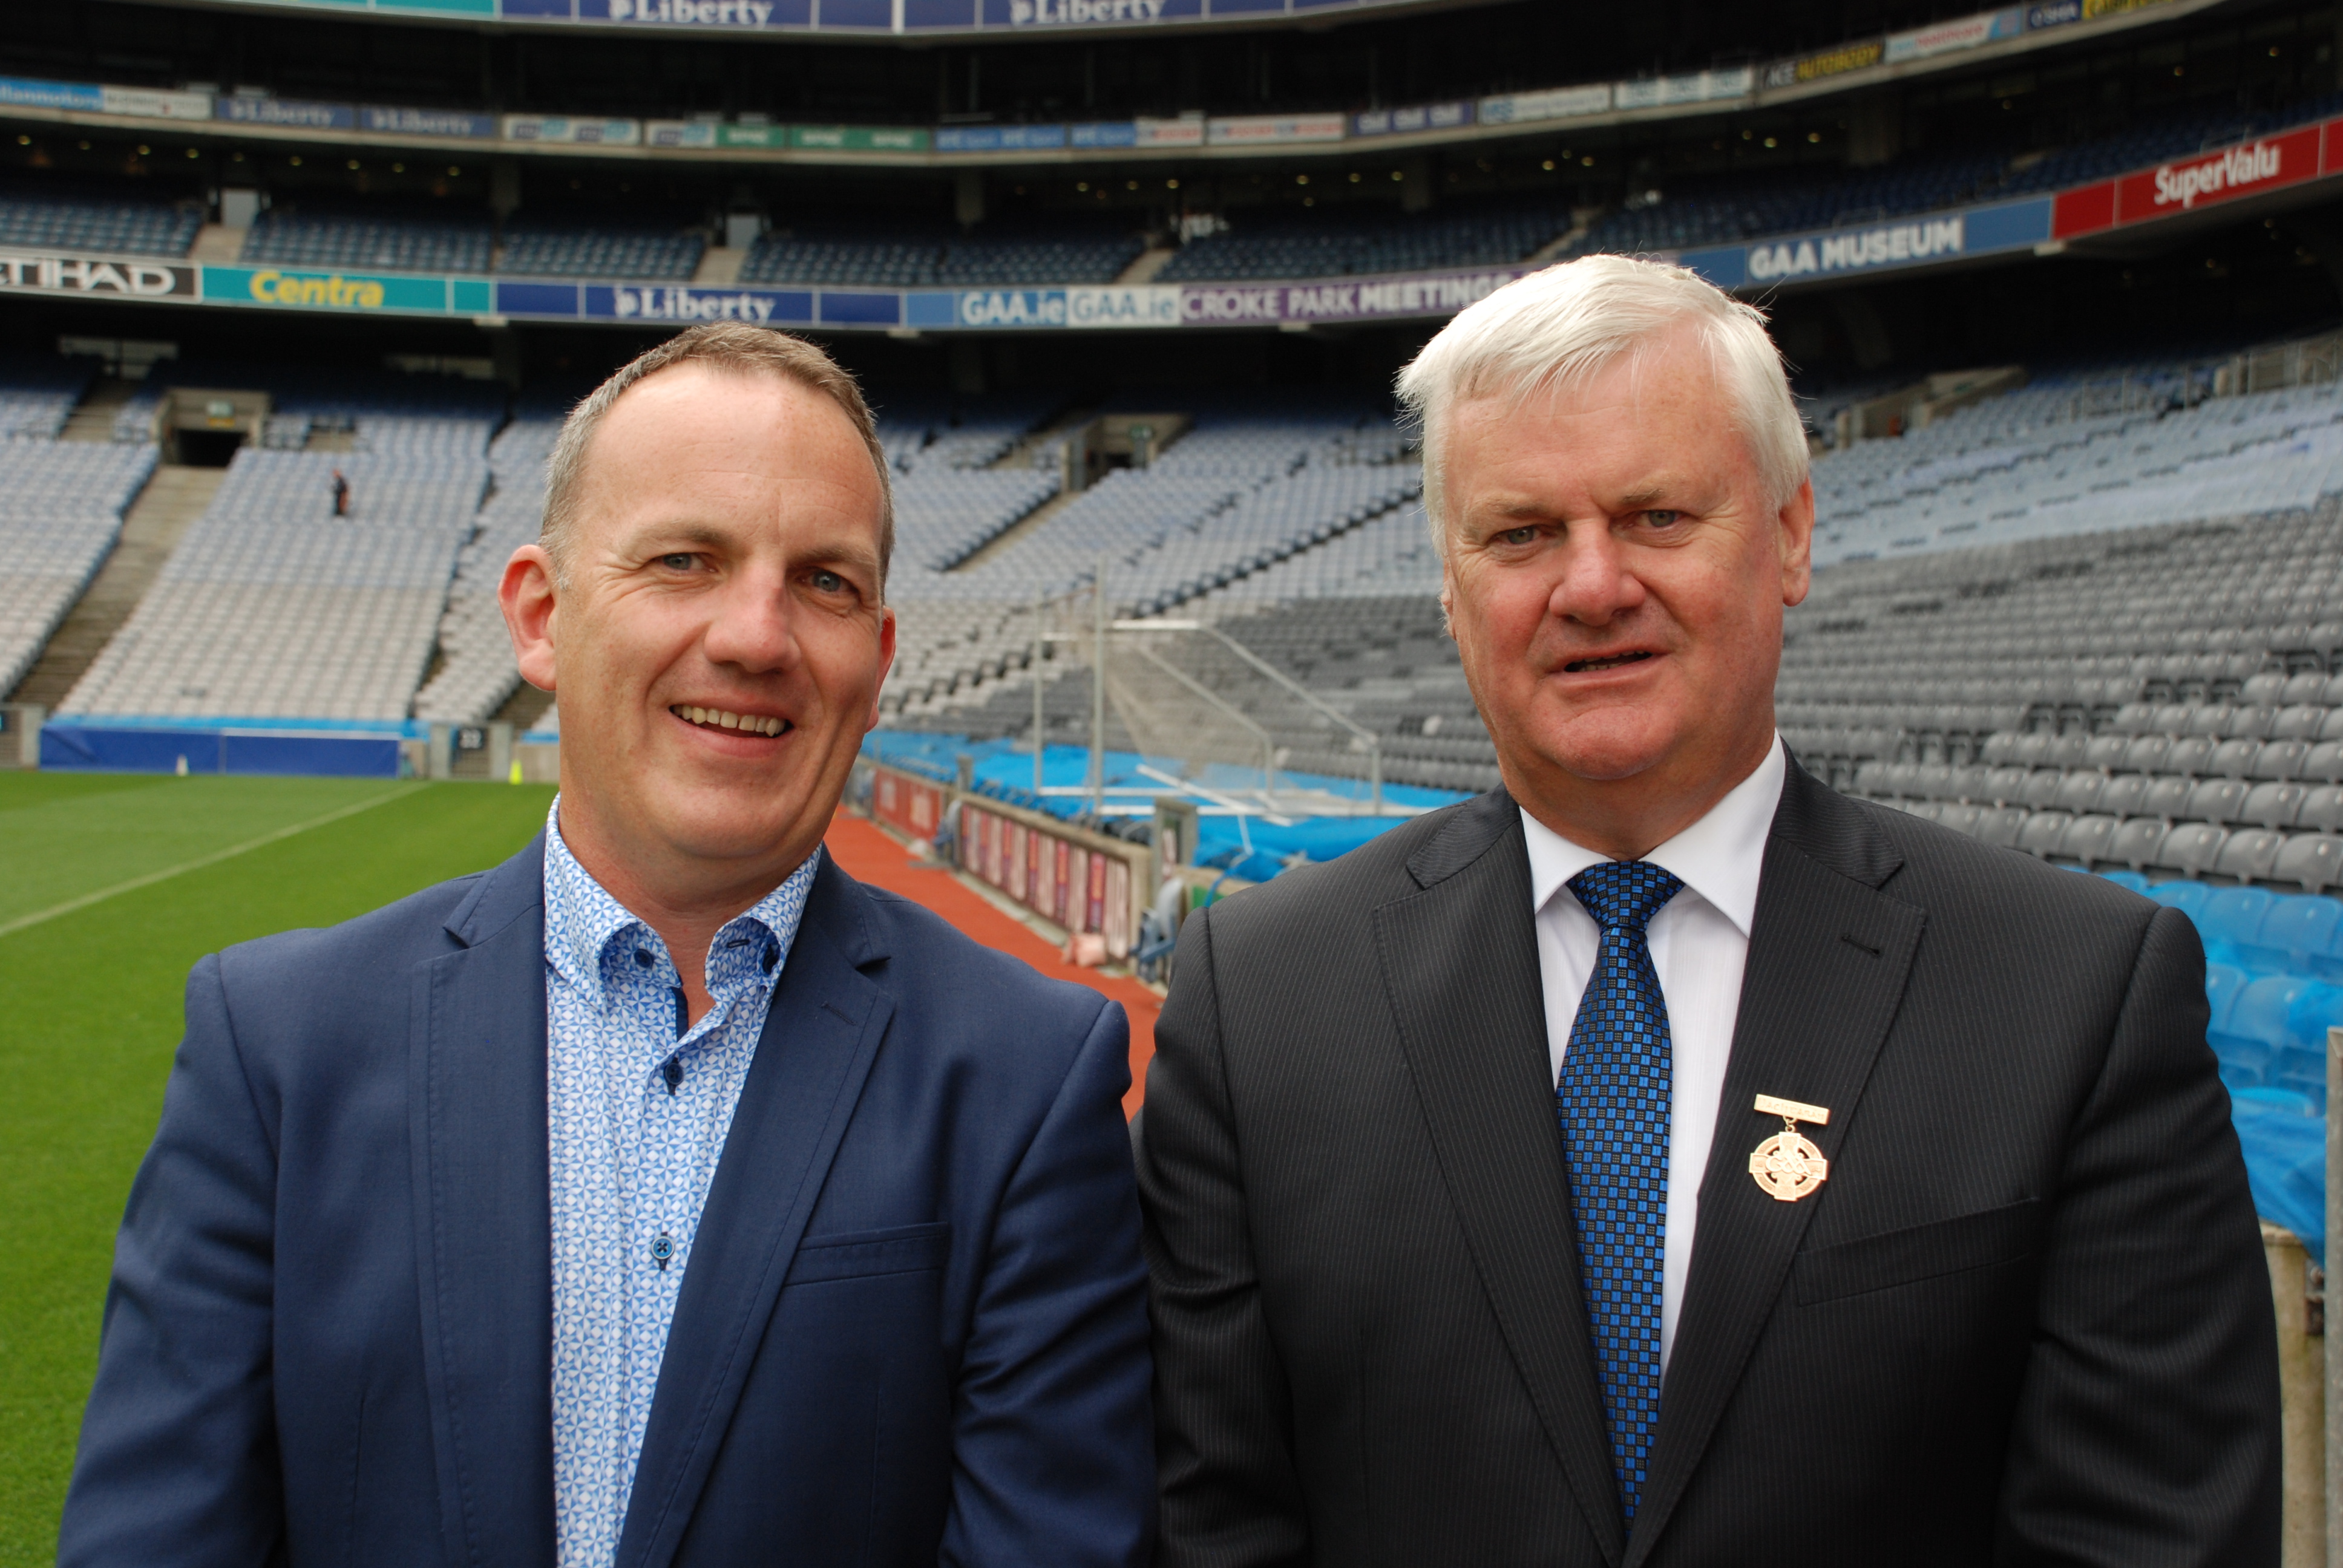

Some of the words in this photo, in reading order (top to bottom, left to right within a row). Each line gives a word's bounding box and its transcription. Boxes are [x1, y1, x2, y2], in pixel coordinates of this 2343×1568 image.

[636, 0, 775, 30] Liberty
[1035, 0, 1165, 25] Liberty
[2154, 140, 2281, 209] SuperValu
[1749, 241, 1818, 280] GAA
[1821, 217, 1963, 271] MUSEUM
[249, 270, 385, 307] Centra
[640, 286, 776, 326] Liberty
[1073, 290, 1175, 321] GAA.ie
[1181, 287, 1279, 321] CROKE
[1287, 285, 1356, 317] PARK
[962, 290, 1066, 325] GAA.ie
